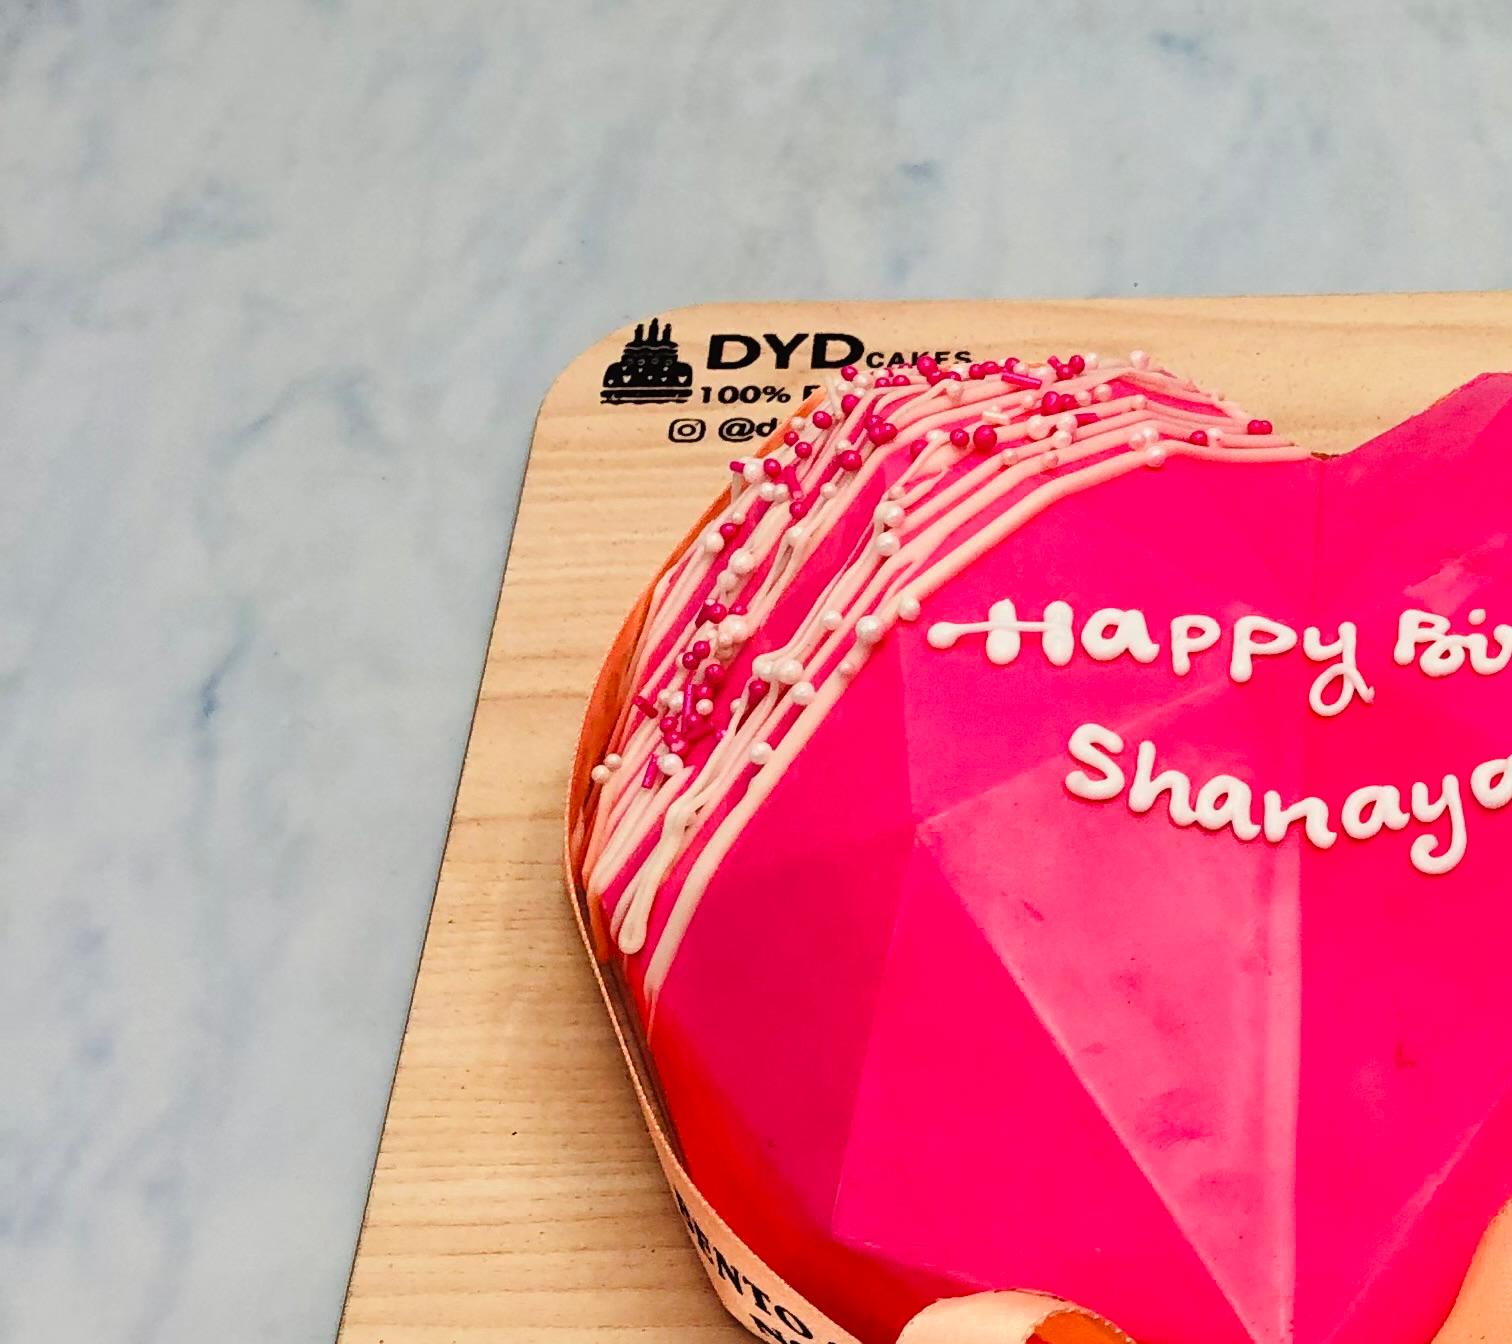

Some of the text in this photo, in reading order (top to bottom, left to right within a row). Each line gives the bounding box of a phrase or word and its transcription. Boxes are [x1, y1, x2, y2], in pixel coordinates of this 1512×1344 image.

[706, 332, 865, 370] DYD
[701, 384, 791, 404] 100%
[928, 598, 1374, 716] Happy
